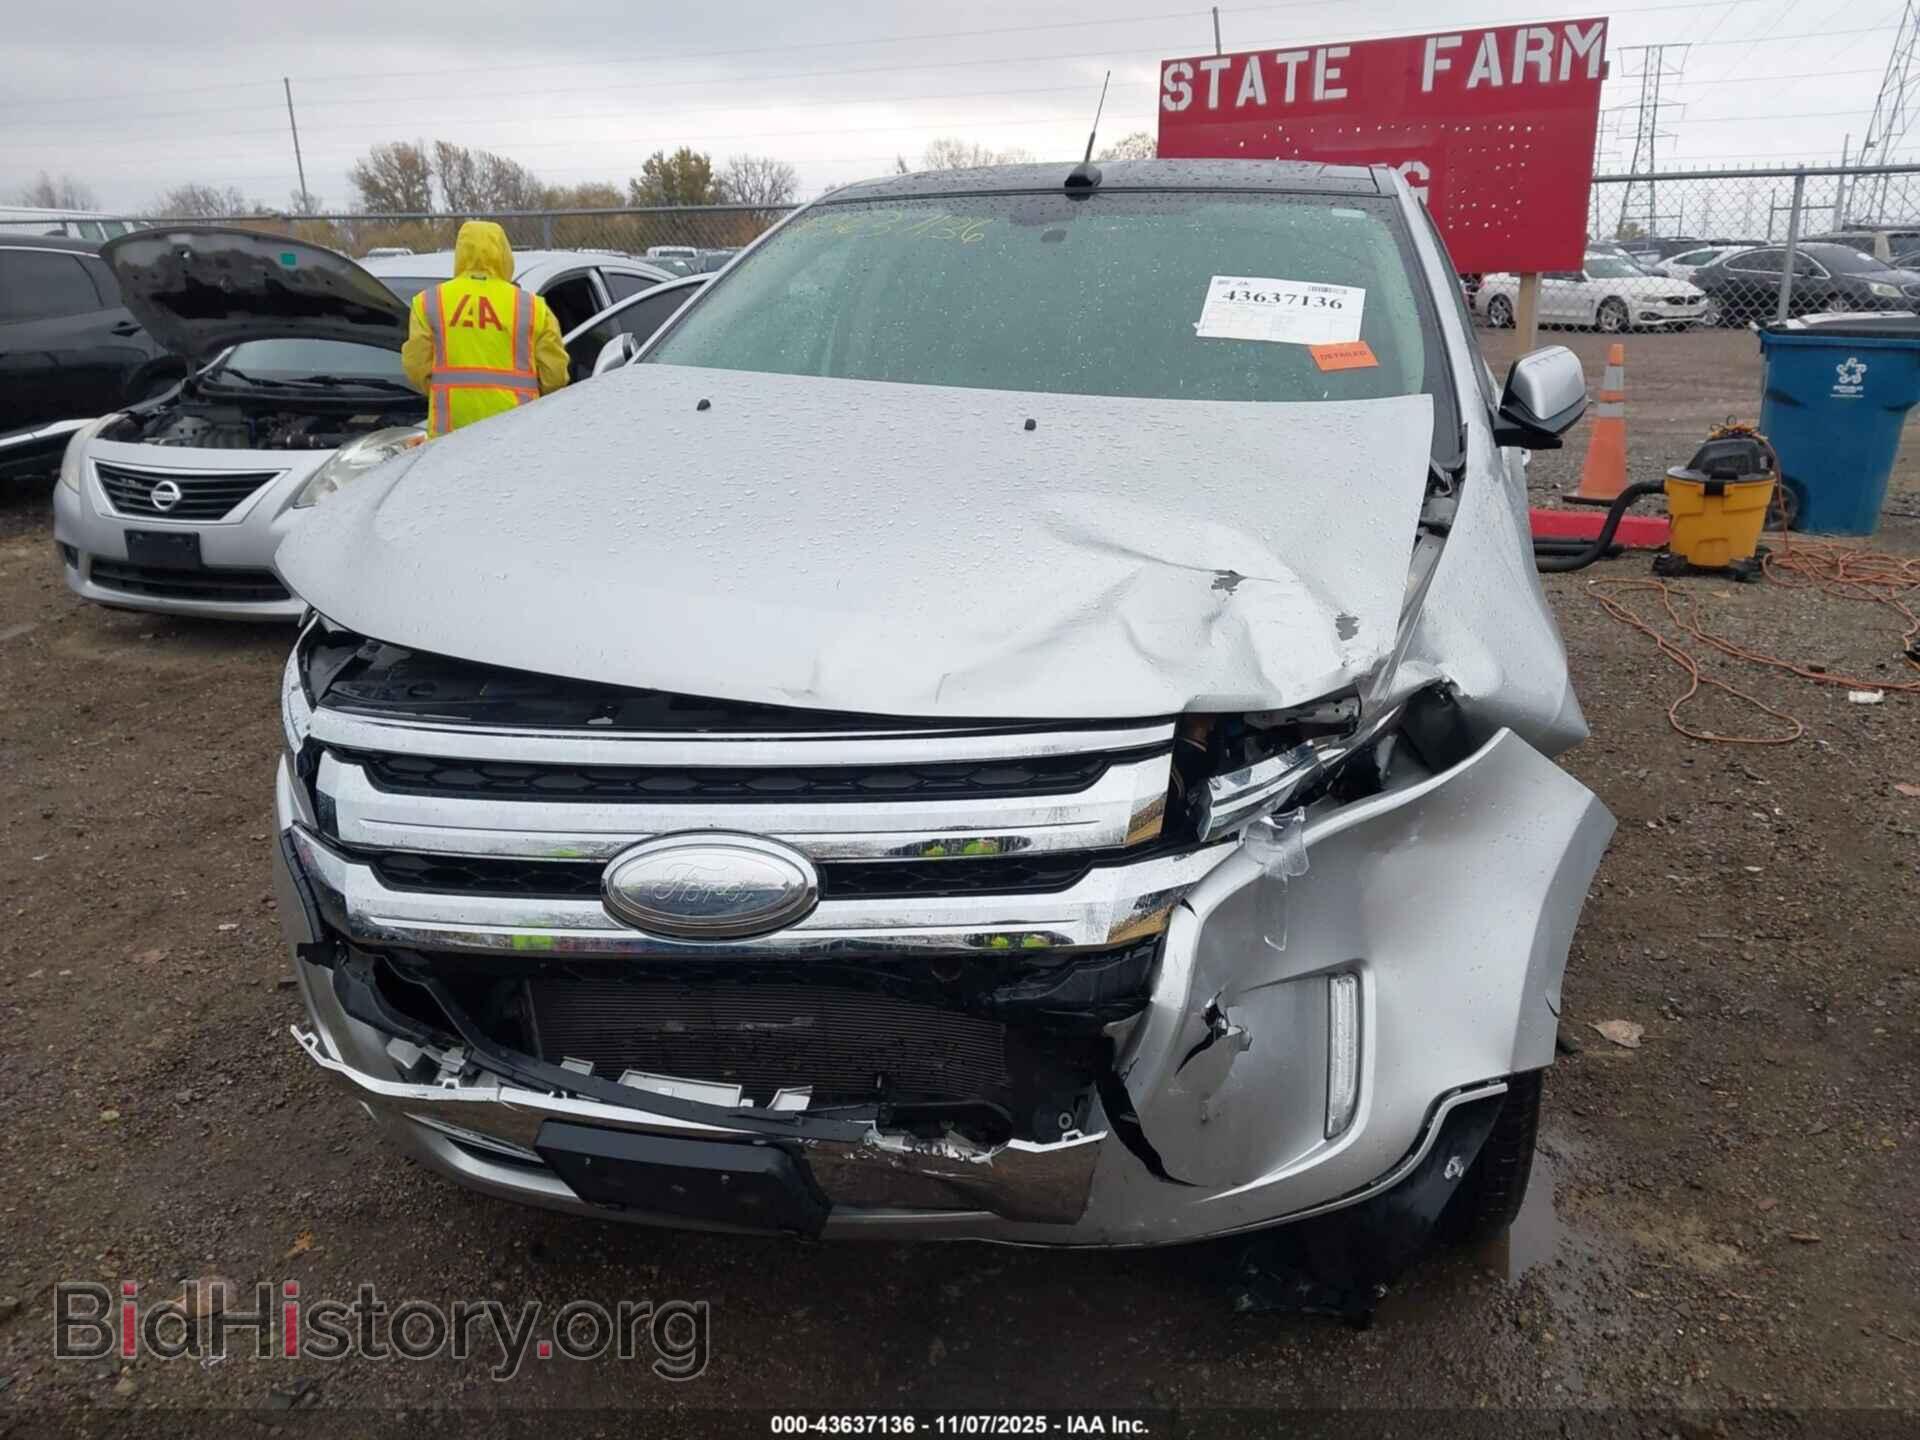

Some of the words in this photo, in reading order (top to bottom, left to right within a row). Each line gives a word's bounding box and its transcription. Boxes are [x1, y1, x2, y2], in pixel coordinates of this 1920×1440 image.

[1161, 46, 1351, 112] STATE
[1421, 22, 1604, 93] FARM
[1222, 289, 1344, 310] 43637136
[650, 862, 754, 904] Ford
